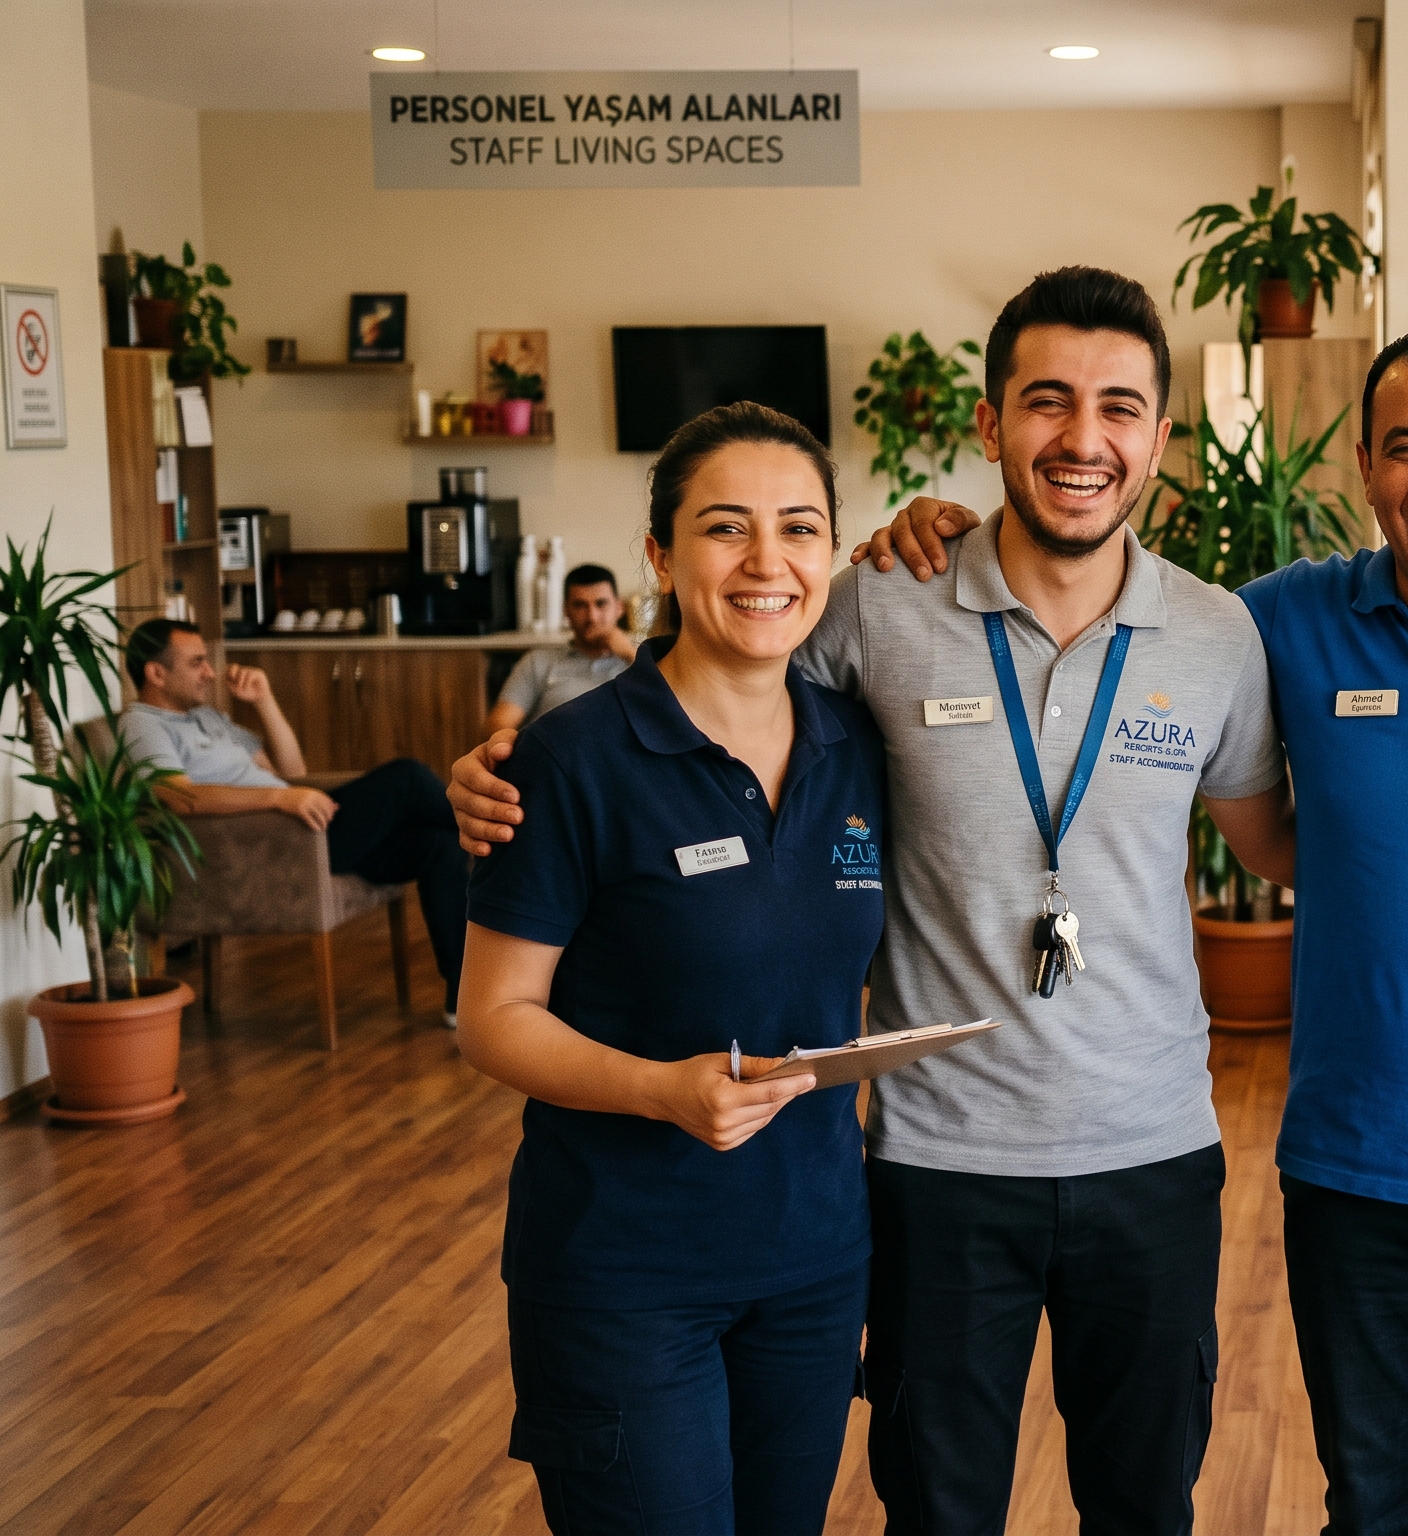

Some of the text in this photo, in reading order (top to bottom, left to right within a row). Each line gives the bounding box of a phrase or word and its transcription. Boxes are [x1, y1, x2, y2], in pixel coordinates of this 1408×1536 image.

[390, 92, 842, 127] PERSONEL YAŞAM ALANLARI
[450, 134, 784, 165] STAFF LIVING SPACES
[1351, 694, 1383, 703] Ahmed
[1114, 718, 1196, 748] AZURA
[1109, 754, 1136, 765] STAFF
[831, 843, 879, 865] AZUR
